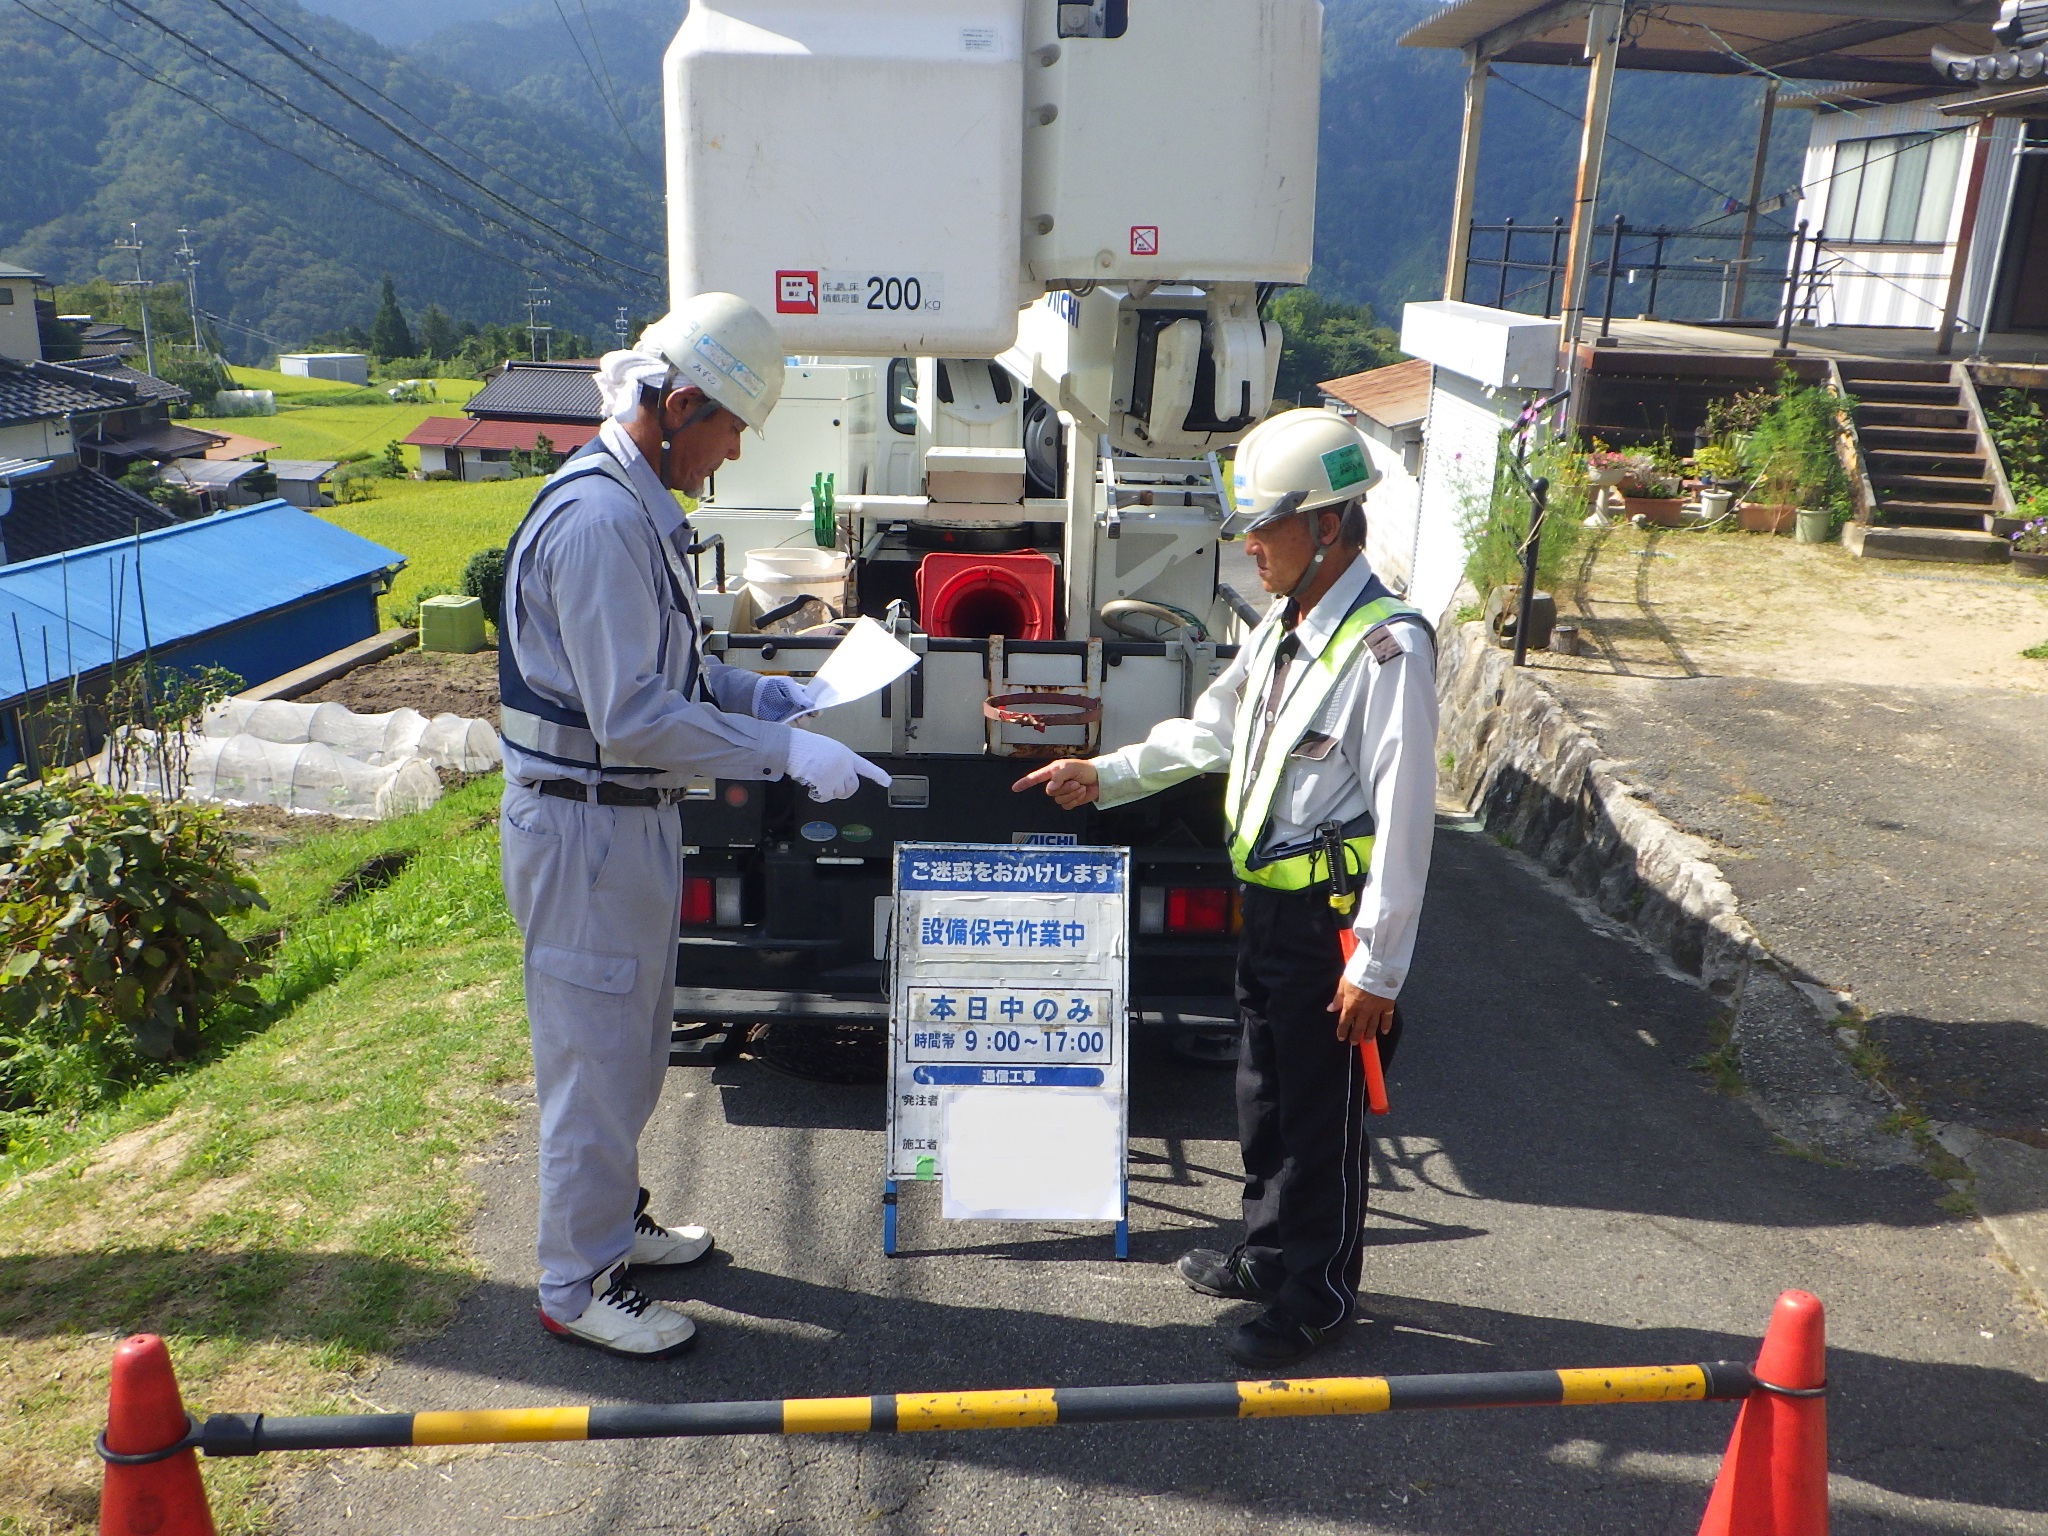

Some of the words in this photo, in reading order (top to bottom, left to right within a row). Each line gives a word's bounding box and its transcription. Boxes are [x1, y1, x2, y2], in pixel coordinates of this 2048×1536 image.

[867, 276, 921, 310] 200
[924, 298, 941, 310] kg
[1025, 834, 1074, 846] AICHI
[911, 860, 1113, 884] ご迷惑をおかけします
[921, 916, 1085, 948] 設備保守作業中
[929, 994, 1093, 1023] 本日中のみ
[914, 1032, 955, 1050] 時間帯
[982, 1069, 1036, 1084] 通信工事
[901, 1094, 939, 1107] 発注者
[902, 1137, 938, 1151] 施工者
